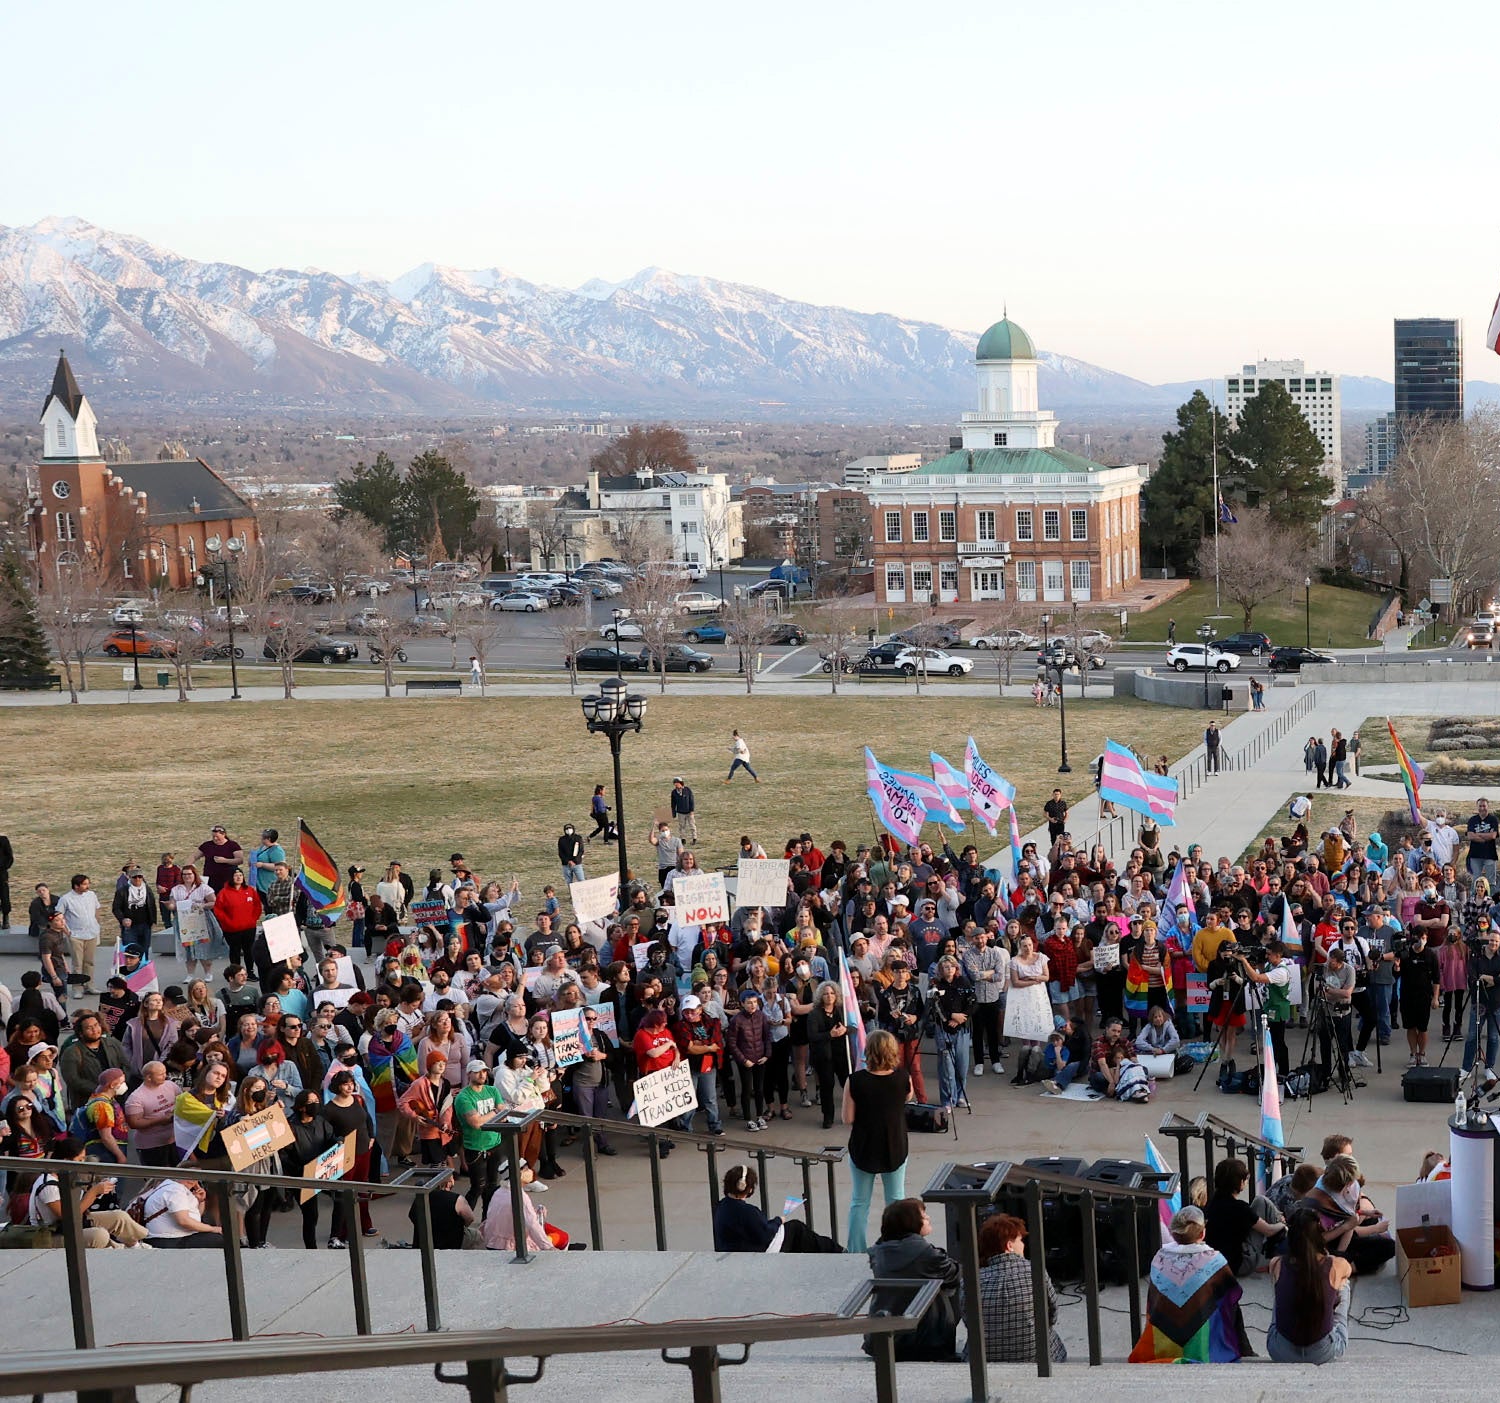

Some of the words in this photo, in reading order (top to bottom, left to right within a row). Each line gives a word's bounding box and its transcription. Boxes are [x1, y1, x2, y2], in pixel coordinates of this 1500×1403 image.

[686, 906, 722, 923] NOW
[558, 1052, 580, 1064] KIDS
[643, 1093, 657, 1105] ALL
[664, 1078, 691, 1095] KIDS
[233, 1125, 248, 1136] YOU
[250, 1111, 274, 1128] BELONG
[251, 1144, 276, 1160] HERE
